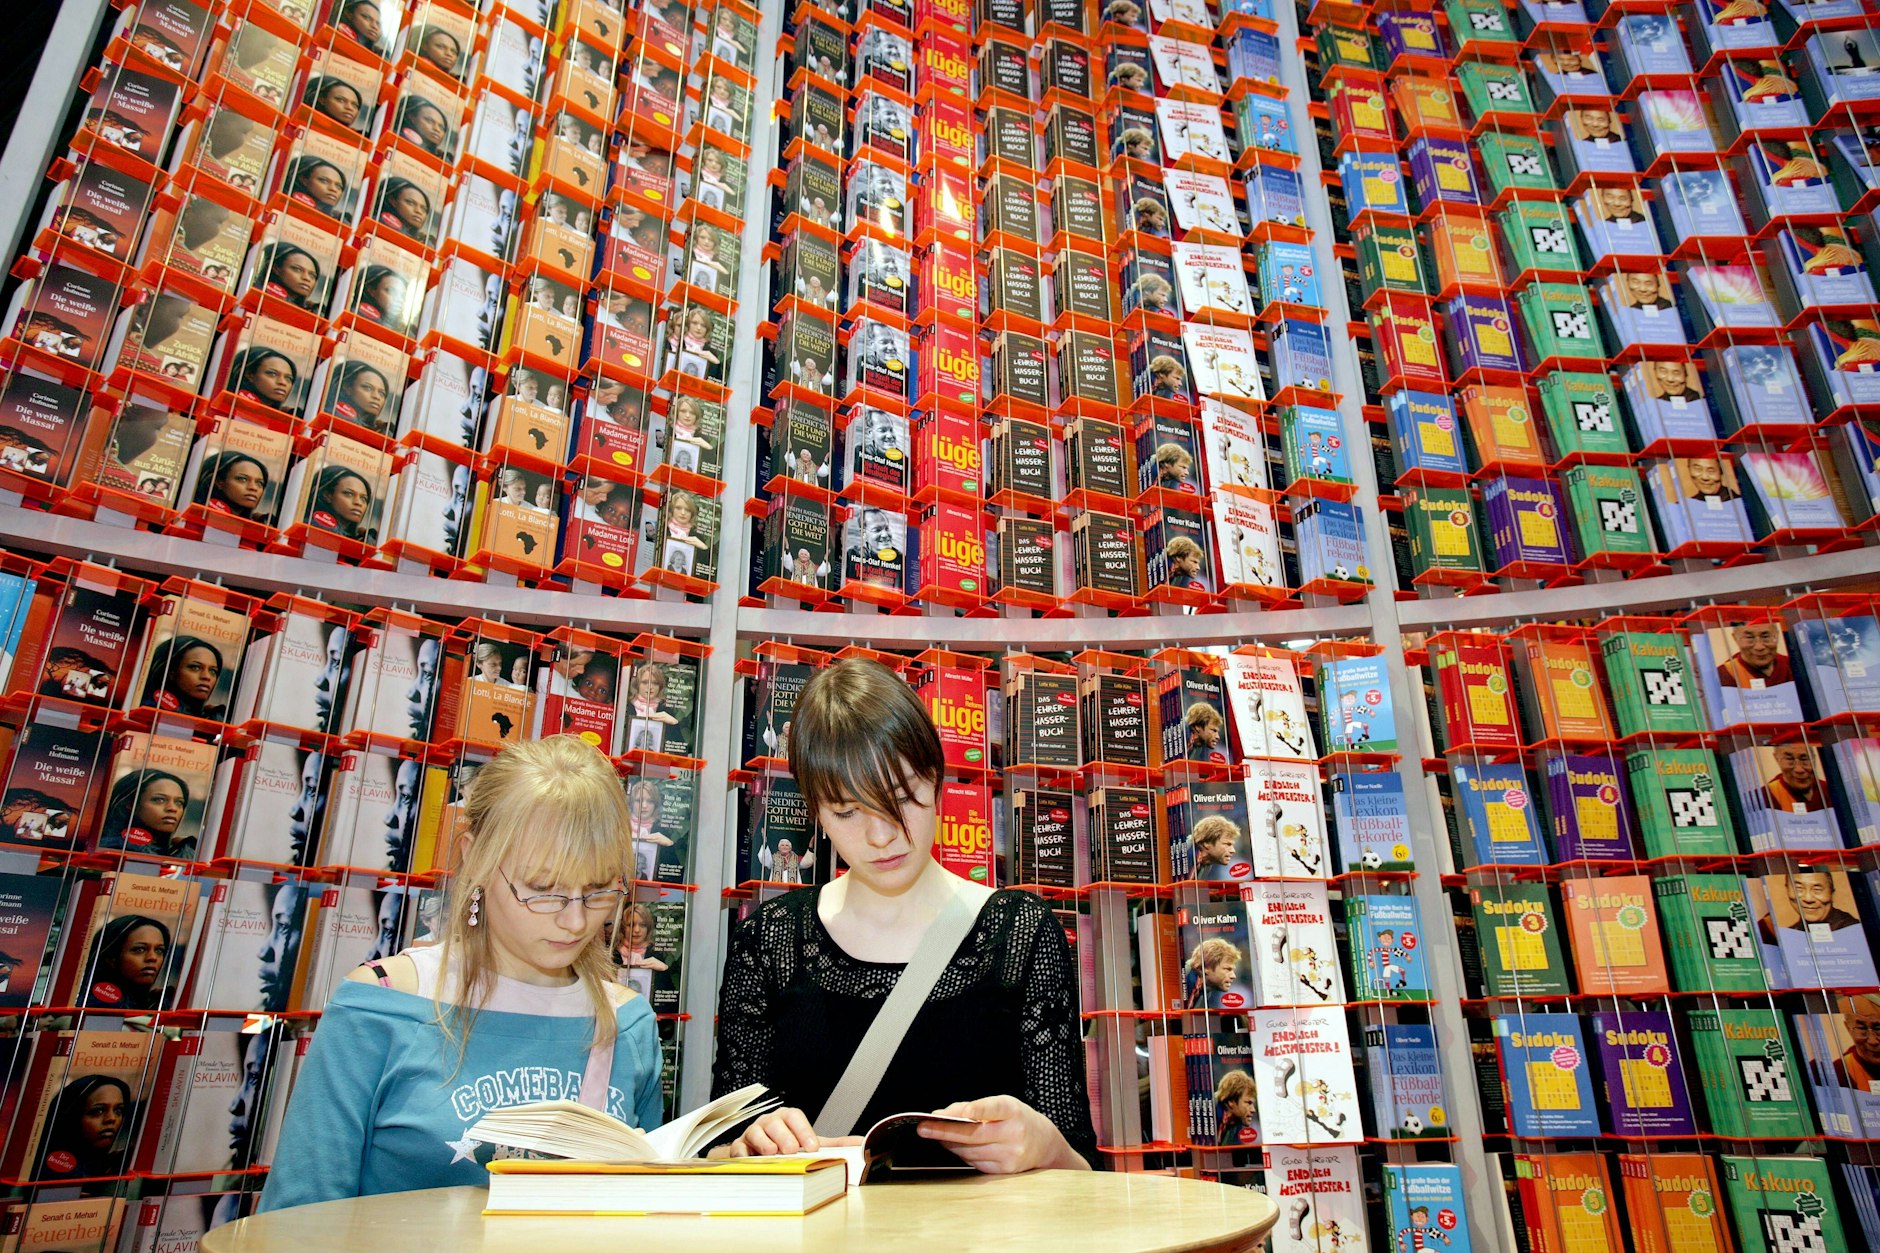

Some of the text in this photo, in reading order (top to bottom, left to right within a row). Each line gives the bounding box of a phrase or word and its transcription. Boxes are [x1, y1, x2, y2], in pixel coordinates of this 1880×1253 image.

[50, 293, 97, 313] Die weiße
[54, 303, 88, 318] Massai
[173, 340, 202, 355] Zurück
[1409, 402, 1450, 414] Sudoku
[15, 405, 64, 425] Die weiße
[20, 415, 55, 430] Massai
[1157, 424, 1190, 436] Oliver Kahn
[932, 434, 981, 469] lüge
[1091, 445, 1118, 455] LEHRER-
[327, 446, 387, 475] Feuerherz
[1092, 455, 1120, 464] HASSER-
[1097, 465, 1117, 473] BUCH
[1589, 475, 1632, 488] Kakuro
[1509, 489, 1554, 503] Sudoku
[1419, 499, 1470, 511] Sudoku
[518, 512, 527, 522] La
[1167, 516, 1200, 529] Oliver Kahn
[788, 520, 826, 534] GOTT UND
[791, 527, 822, 540] DIE WELT
[588, 527, 634, 545] Madame Lotti
[935, 530, 984, 566] lüge
[1098, 541, 1128, 550] LEHRER-
[1100, 550, 1129, 559] HASSER-
[851, 555, 901, 570] Hans-Olaf Henkel
[1105, 561, 1126, 569] BUCH
[93, 614, 120, 627] Hofmann
[96, 609, 120, 620] Corinne
[79, 623, 125, 643] Die weiße
[174, 615, 243, 643] Feuerherz
[83, 634, 116, 650] Massai
[280, 645, 323, 663] SKLAVIN
[1632, 643, 1677, 656] Kakuro
[372, 661, 413, 676] SKLAVIN
[1460, 662, 1503, 676] Sudoku
[1545, 657, 1588, 670] Sudoku
[1186, 680, 1220, 692] Oliver Kahn
[473, 687, 531, 708] Lotti, La Blanche
[564, 704, 596, 716] Madame
[598, 710, 614, 720] Lotti
[932, 697, 983, 735] lüge
[1108, 706, 1139, 715] LEHRER-
[1110, 717, 1141, 727] HASSER-
[1039, 727, 1064, 737] BUCH
[1115, 729, 1136, 738] BUCH
[52, 744, 79, 754] Corinne
[48, 750, 79, 762] Hofmann
[132, 748, 209, 773] Feuerherz
[34, 761, 85, 778] Die weiße
[1657, 761, 1708, 775] Kakuro
[39, 772, 75, 785] Massai
[254, 775, 297, 791] SKLAVIN
[1469, 778, 1522, 791] Sudoku
[1569, 771, 1616, 785] Sudoku
[349, 785, 391, 799] SKLAVIN
[1193, 793, 1236, 802] Oliver Kahn
[1368, 796, 1397, 805] kleine
[767, 806, 791, 814] GOTT
[1350, 805, 1398, 817] Lexikon
[770, 815, 807, 825] DIE WELT
[1114, 820, 1147, 830] LEHRER-
[935, 815, 991, 854] lüge
[1116, 831, 1149, 842] HASSER-
[1353, 830, 1403, 842] rekorde
[1121, 844, 1145, 854] BUCH
[131, 883, 150, 891] Senait
[158, 887, 179, 895] Mehari
[1691, 886, 1743, 902] Kakuro
[114, 892, 193, 913] Feuerherz
[1268, 902, 1306, 912] ENDLICH
[1483, 900, 1544, 914] Sudoku
[1577, 893, 1644, 909] Sudoku
[1193, 915, 1237, 924] Oliver Kahn
[1370, 910, 1412, 920] Fußballwitze
[1626, 911, 1638, 924] 5
[217, 918, 267, 930] SKLAVIN
[331, 922, 374, 935] SKLAVIN
[1529, 918, 1539, 930] 3
[95, 986, 119, 1000] Bestseller
[1272, 1031, 1318, 1042] ENDLICH
[1725, 1023, 1778, 1039] Kakuro
[91, 1040, 140, 1049] Senait G. Mehari
[1511, 1032, 1575, 1048] Sudoku
[1605, 1030, 1668, 1046] Sudoku
[1217, 1045, 1238, 1055] Oliver
[1652, 1048, 1663, 1062] 4
[73, 1052, 154, 1069] Feuerherz
[1406, 1052, 1435, 1062] kleine
[1390, 1062, 1435, 1074] Lexikon
[194, 1072, 239, 1083] SKLAVIN
[451, 1066, 628, 1122] COMEBAK
[1394, 1091, 1440, 1105] rekorde
[48, 1156, 74, 1170] Bestseller
[59, 1153, 70, 1161] Der
[1287, 1169, 1331, 1181] ENDLICH
[1744, 1171, 1816, 1192] Kakuro
[1546, 1174, 1602, 1191] Sudoku
[1654, 1174, 1709, 1193] Sudoku
[1401, 1185, 1452, 1194] Fußballwitze
[1590, 1193, 1599, 1210] 5
[1697, 1195, 1707, 1211] 5
[42, 1211, 98, 1222] Senait G. Mehari
[21, 1224, 115, 1244] Feuerherz
